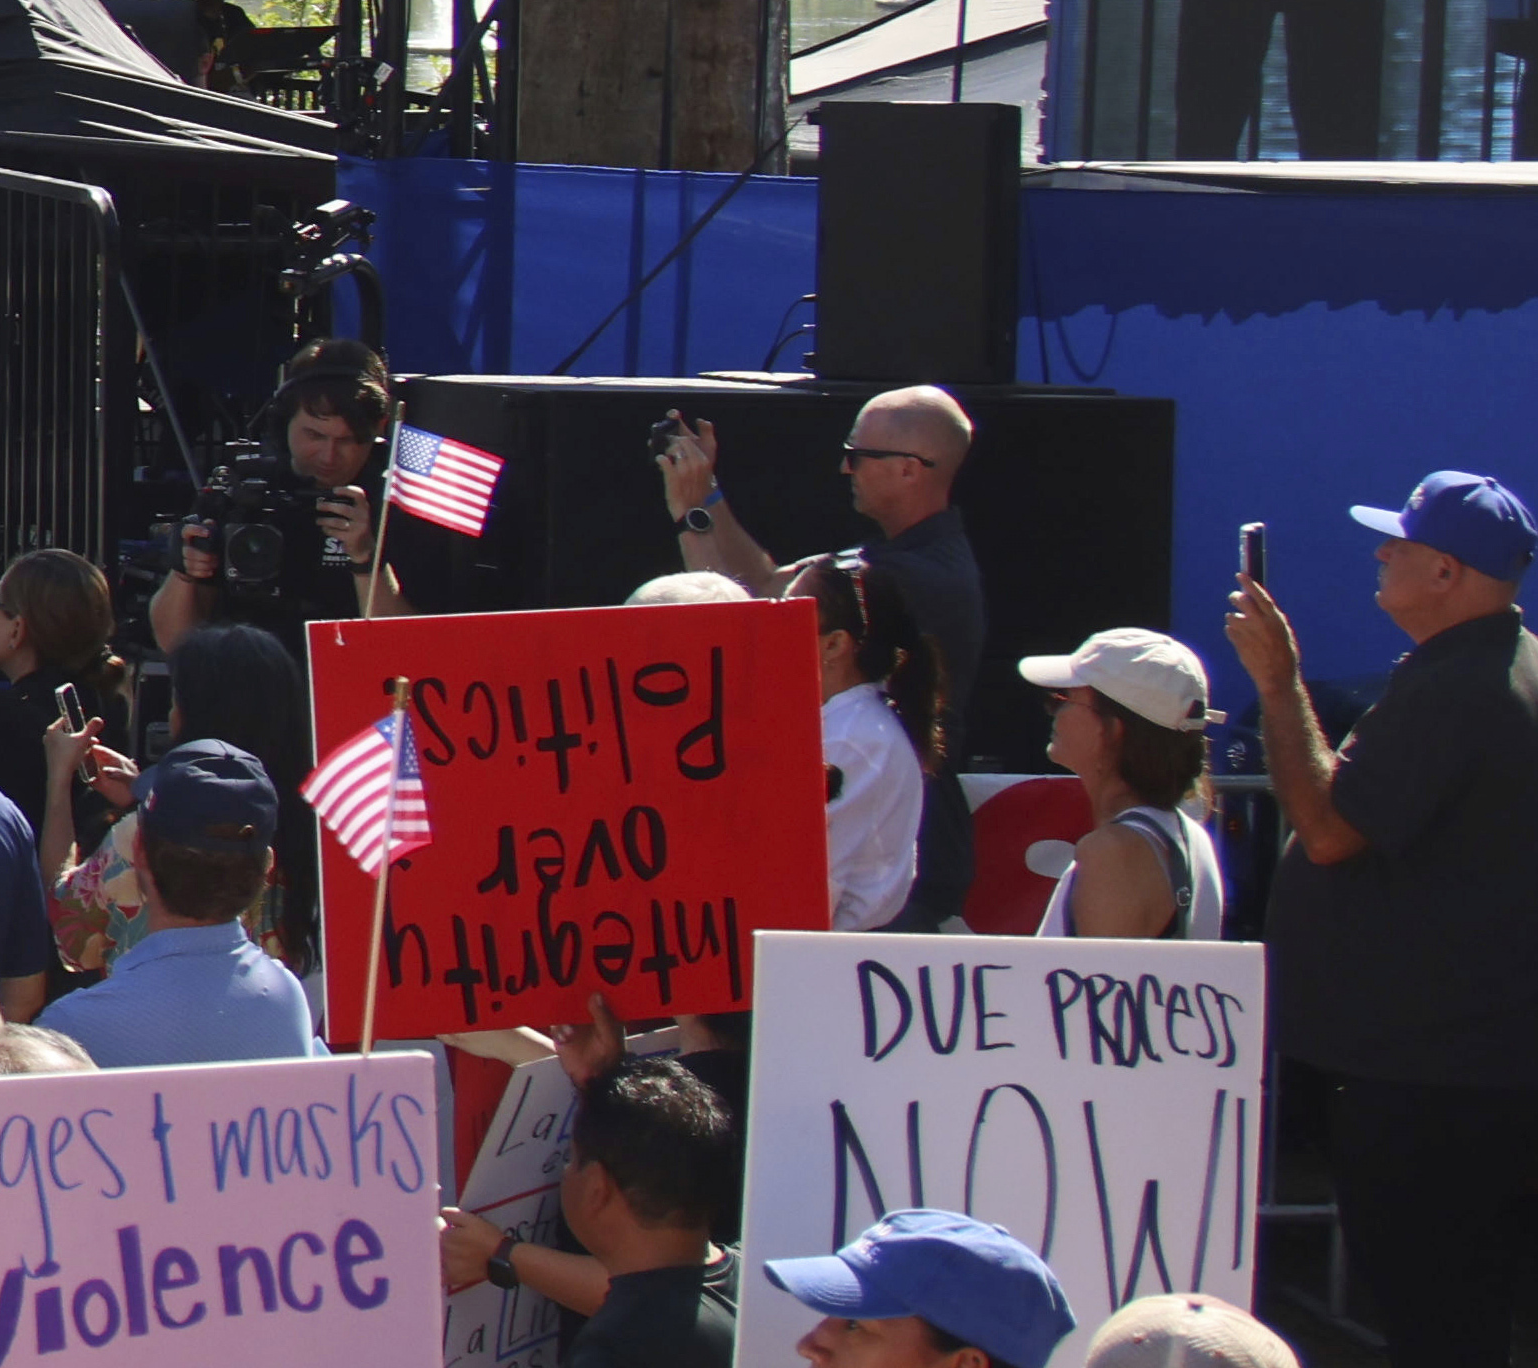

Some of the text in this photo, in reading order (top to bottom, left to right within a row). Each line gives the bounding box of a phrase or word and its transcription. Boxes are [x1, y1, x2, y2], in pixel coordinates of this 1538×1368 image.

[476, 805, 668, 896] over
[384, 857, 744, 1025] Integrity
[857, 960, 1014, 1062] DUE
[210, 1072, 433, 1192] masks
